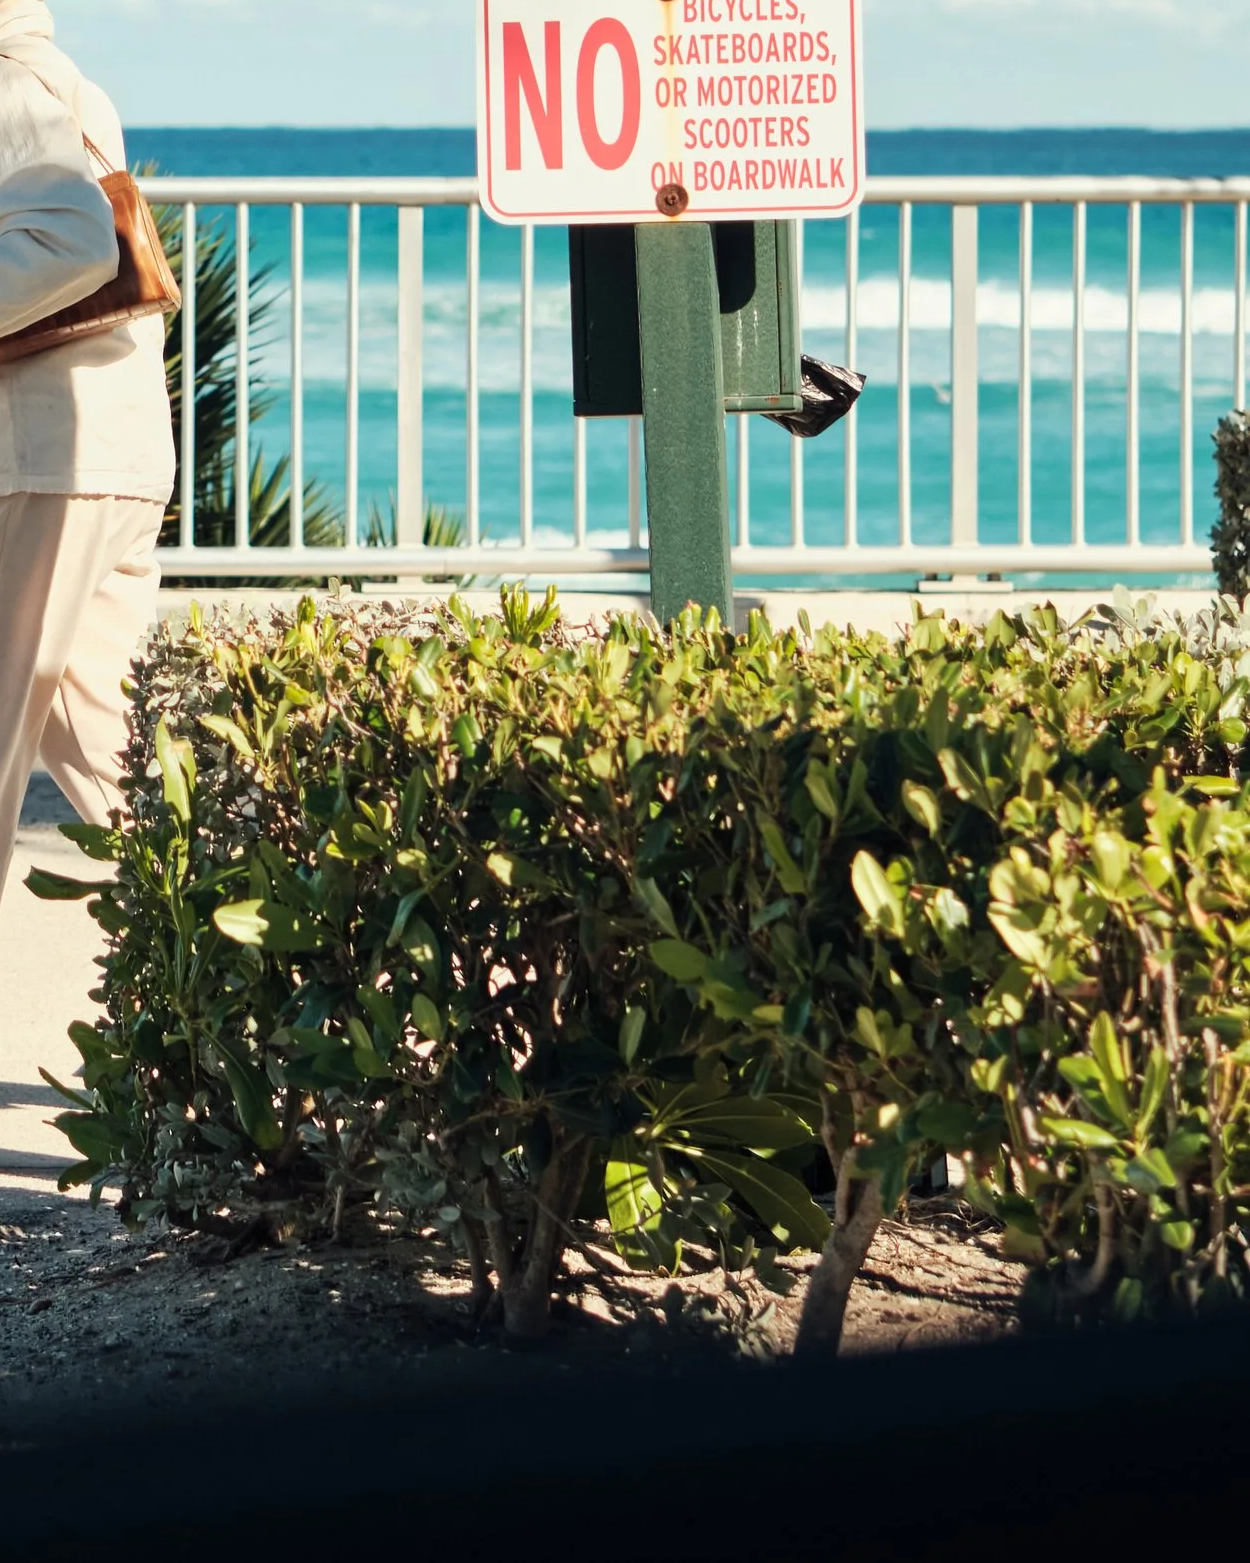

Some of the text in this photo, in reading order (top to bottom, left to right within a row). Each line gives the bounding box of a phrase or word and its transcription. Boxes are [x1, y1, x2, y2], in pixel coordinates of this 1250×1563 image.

[653, 31, 837, 66] SKATEBOARDS,
[502, 17, 641, 171] NO
[655, 73, 837, 108] OR MOTORIZED
[683, 116, 810, 150] SCOOTERS
[650, 157, 845, 192] ON BOARDWALK
